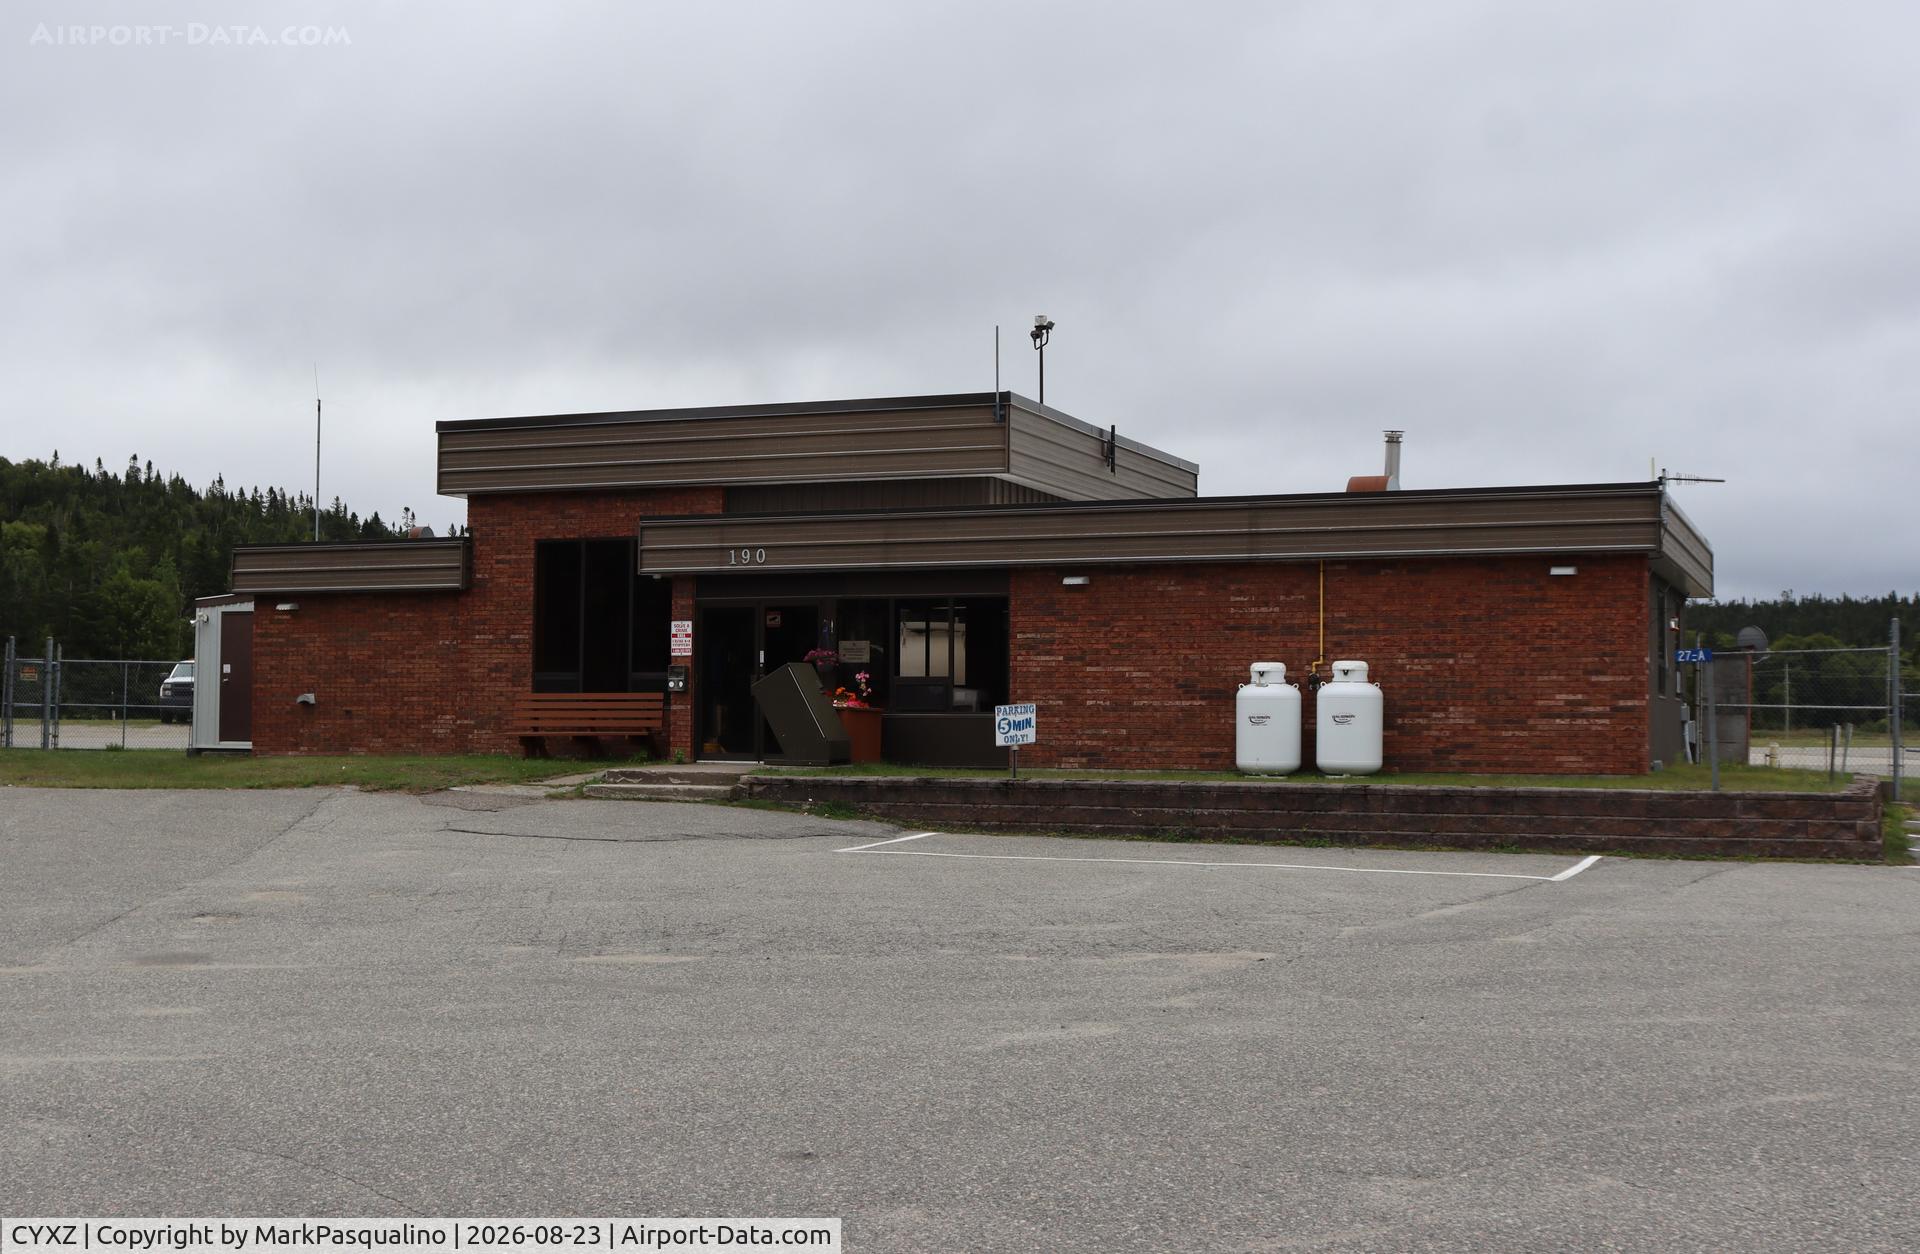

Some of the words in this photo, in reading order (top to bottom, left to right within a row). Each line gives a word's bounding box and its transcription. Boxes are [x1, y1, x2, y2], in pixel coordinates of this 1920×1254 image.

[729, 548, 766, 565] 190
[996, 704, 1035, 716] PARKING
[1012, 717, 1034, 731] MIN.
[1003, 733, 1029, 744] ONLY!
